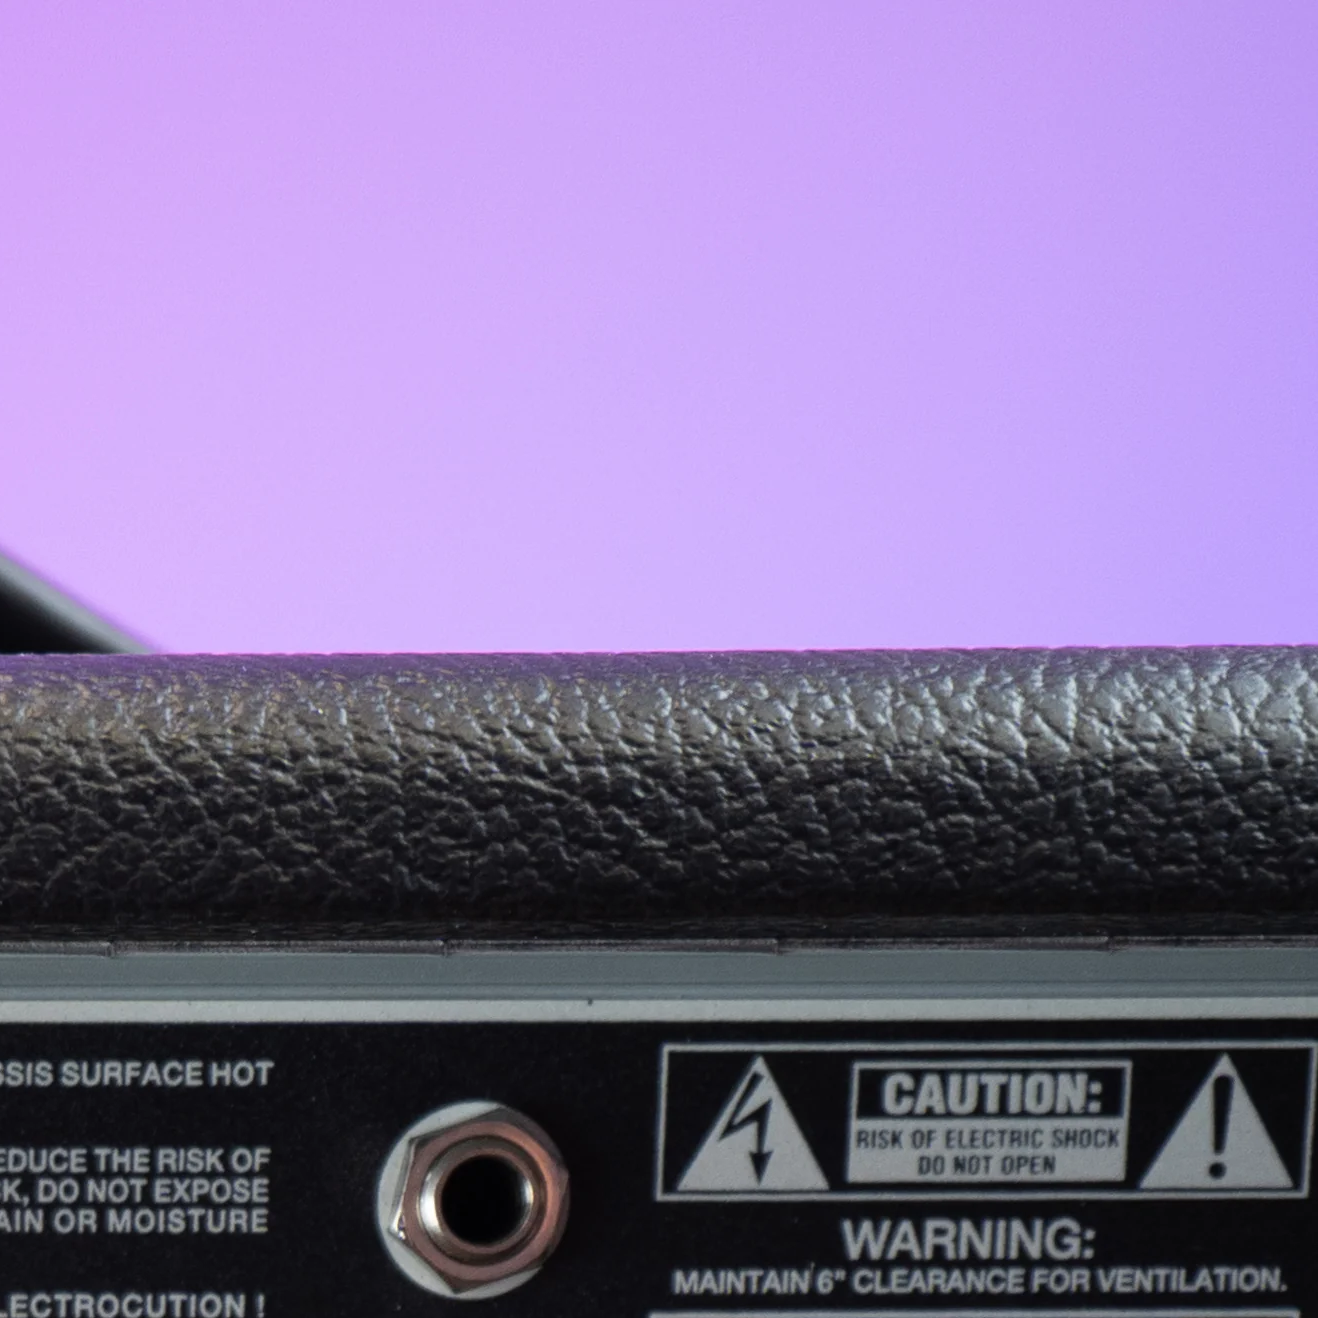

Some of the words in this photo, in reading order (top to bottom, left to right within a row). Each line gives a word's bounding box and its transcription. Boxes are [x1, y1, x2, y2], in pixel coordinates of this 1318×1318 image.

[60, 1060, 204, 1087] SURFACE
[209, 1059, 275, 1087] HOT
[882, 1072, 1102, 1116] CAUTION:
[855, 1127, 905, 1151] RISK
[910, 1127, 941, 1151] OF
[944, 1127, 1046, 1151] ELECTRIC
[1050, 1127, 1120, 1151] SHOCK
[93, 1147, 150, 1174] THE
[156, 1147, 225, 1174] RISK
[230, 1146, 272, 1174] OF
[916, 1153, 946, 1177] DO
[951, 1153, 996, 1177] NOT
[1001, 1153, 1056, 1177] OPEN
[36, 1177, 80, 1204] DO
[86, 1177, 148, 1204] NOT
[153, 1177, 269, 1204] EXPOSE
[52, 1207, 98, 1234] OR
[106, 1207, 269, 1234] MOISTURE
[841, 1217, 1096, 1261] WARNING:
[673, 1269, 812, 1295] MAINTAIN
[815, 1268, 847, 1295] 6"
[851, 1267, 1026, 1295] CLEARANCE
[1030, 1267, 1091, 1294] FOR
[1097, 1267, 1288, 1294] VENTILATION.
